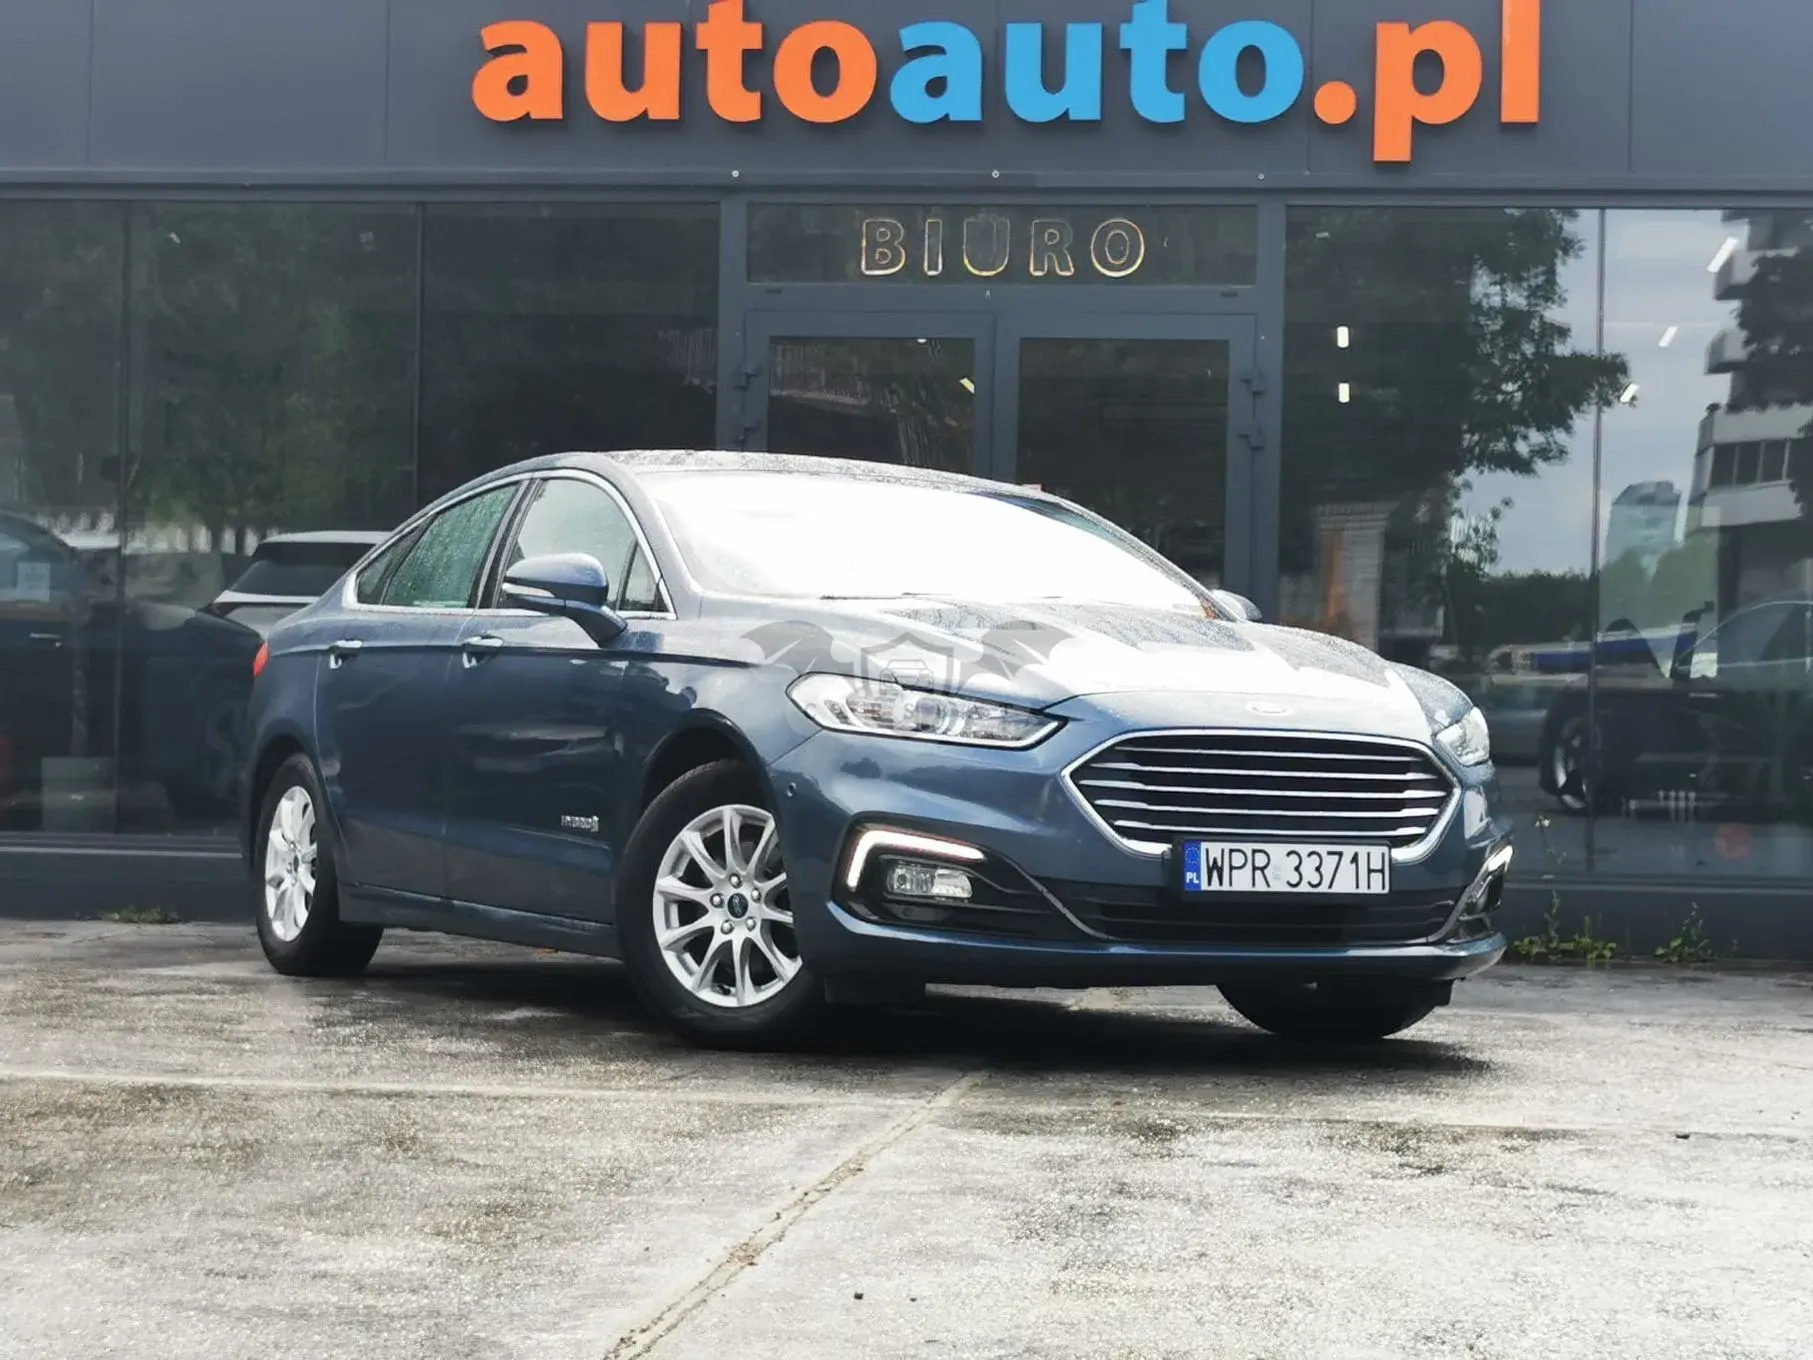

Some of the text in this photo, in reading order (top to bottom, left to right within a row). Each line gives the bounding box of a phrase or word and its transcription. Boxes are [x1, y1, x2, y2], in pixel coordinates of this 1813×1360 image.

[471, 0, 1541, 162] autoauto.pl
[861, 217, 1145, 277] BIURO
[1185, 871, 1200, 885] PL
[1205, 848, 1386, 890] WPR 3371H
